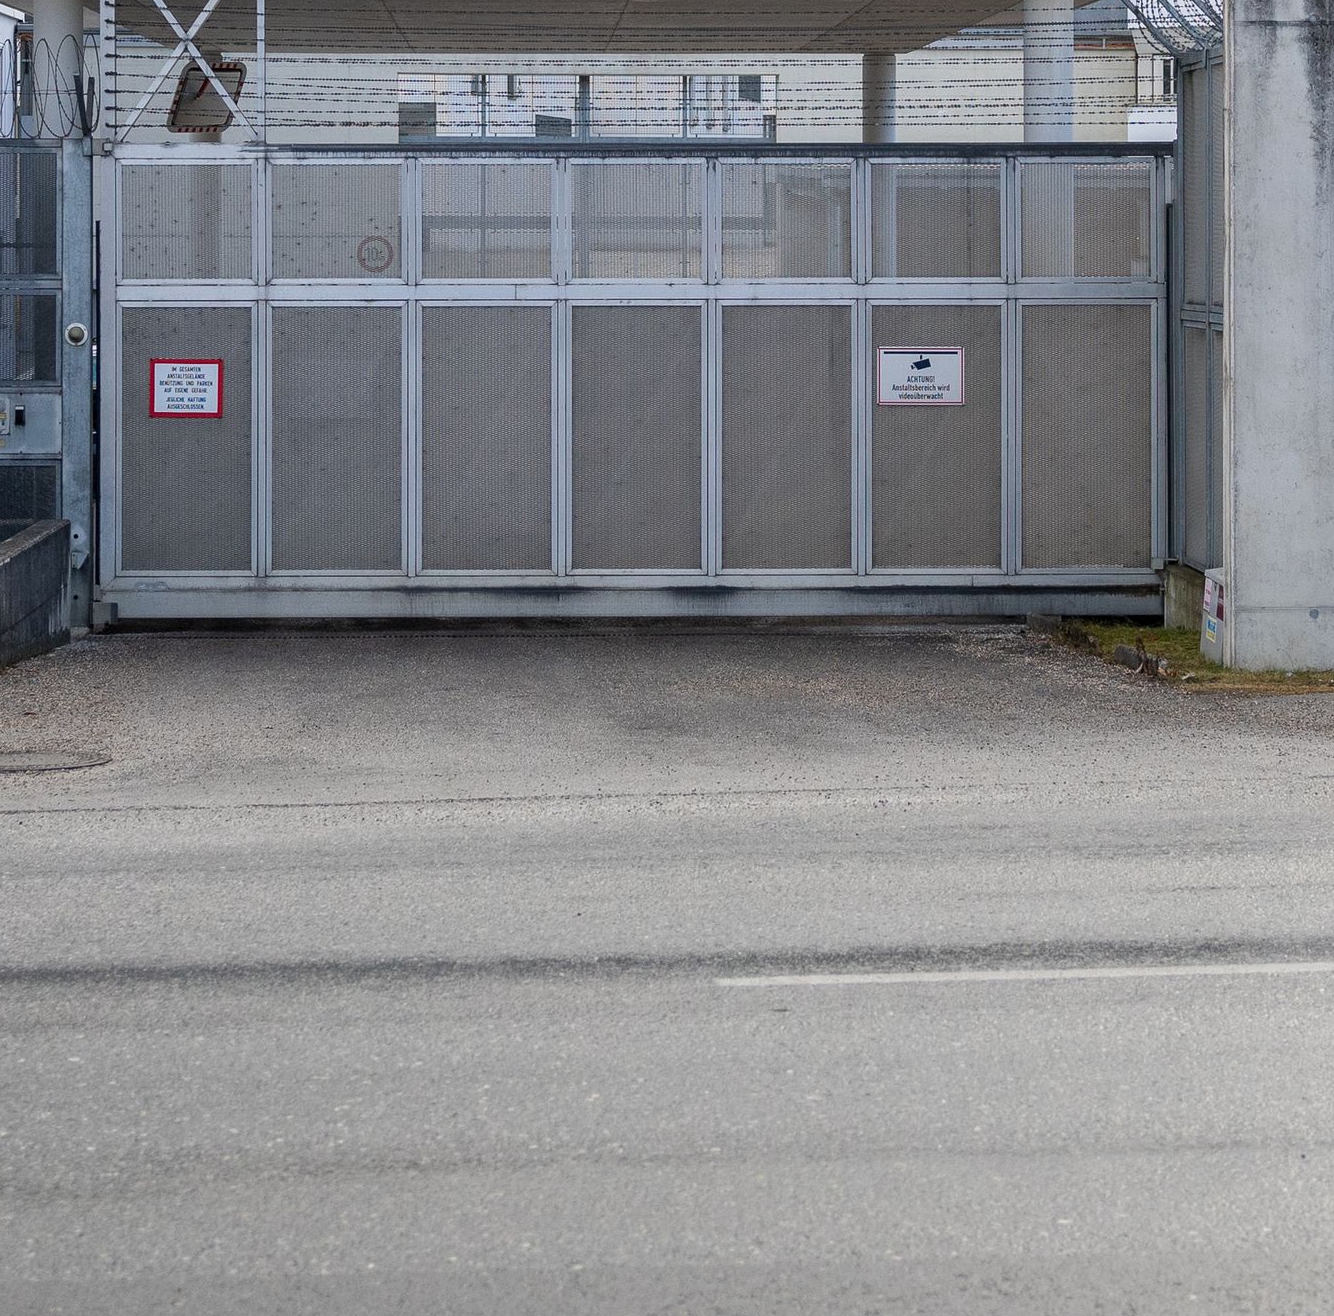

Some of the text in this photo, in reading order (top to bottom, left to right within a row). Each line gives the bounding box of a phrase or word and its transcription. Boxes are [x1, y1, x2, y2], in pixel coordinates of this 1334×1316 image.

[906, 375, 936, 383] ACHTUNG!
[937, 383, 951, 391] wird
[898, 392, 944, 400] videoüberwacht
